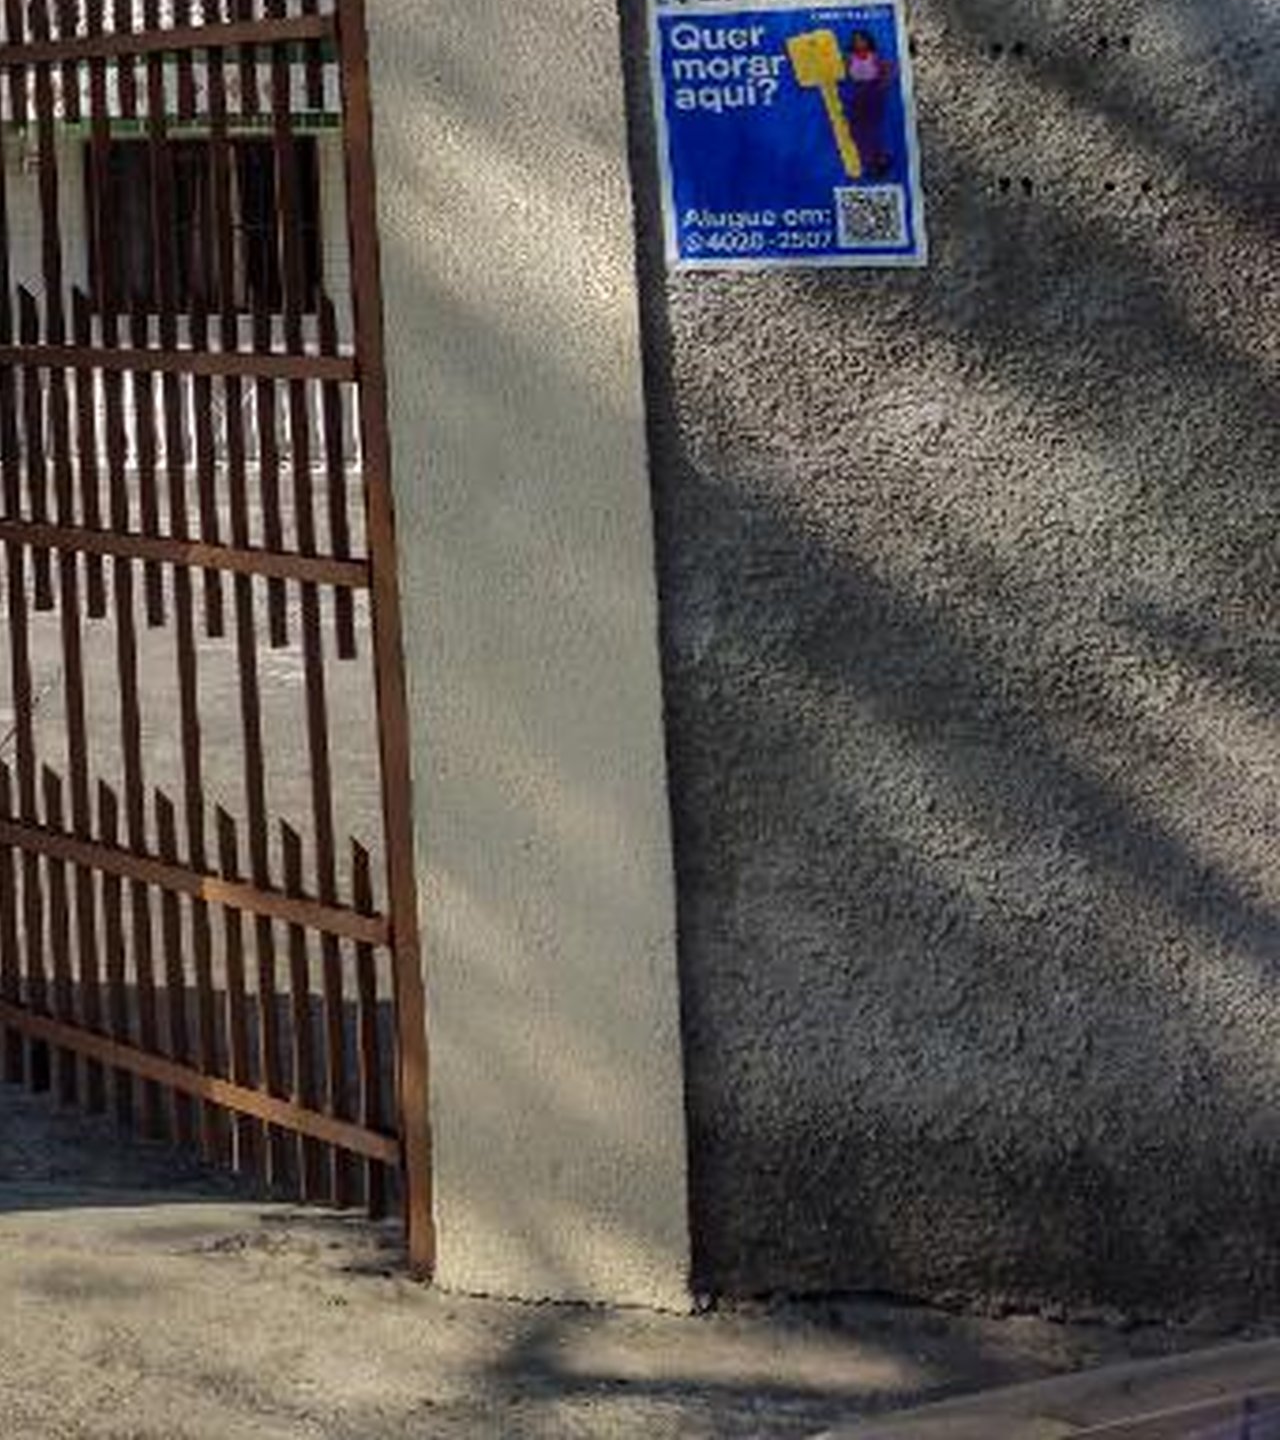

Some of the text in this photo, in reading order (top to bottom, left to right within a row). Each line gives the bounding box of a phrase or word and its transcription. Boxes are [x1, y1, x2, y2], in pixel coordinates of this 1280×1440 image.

[671, 23, 765, 51] Quer
[672, 54, 786, 81] morar
[674, 78, 778, 113] aqui?
